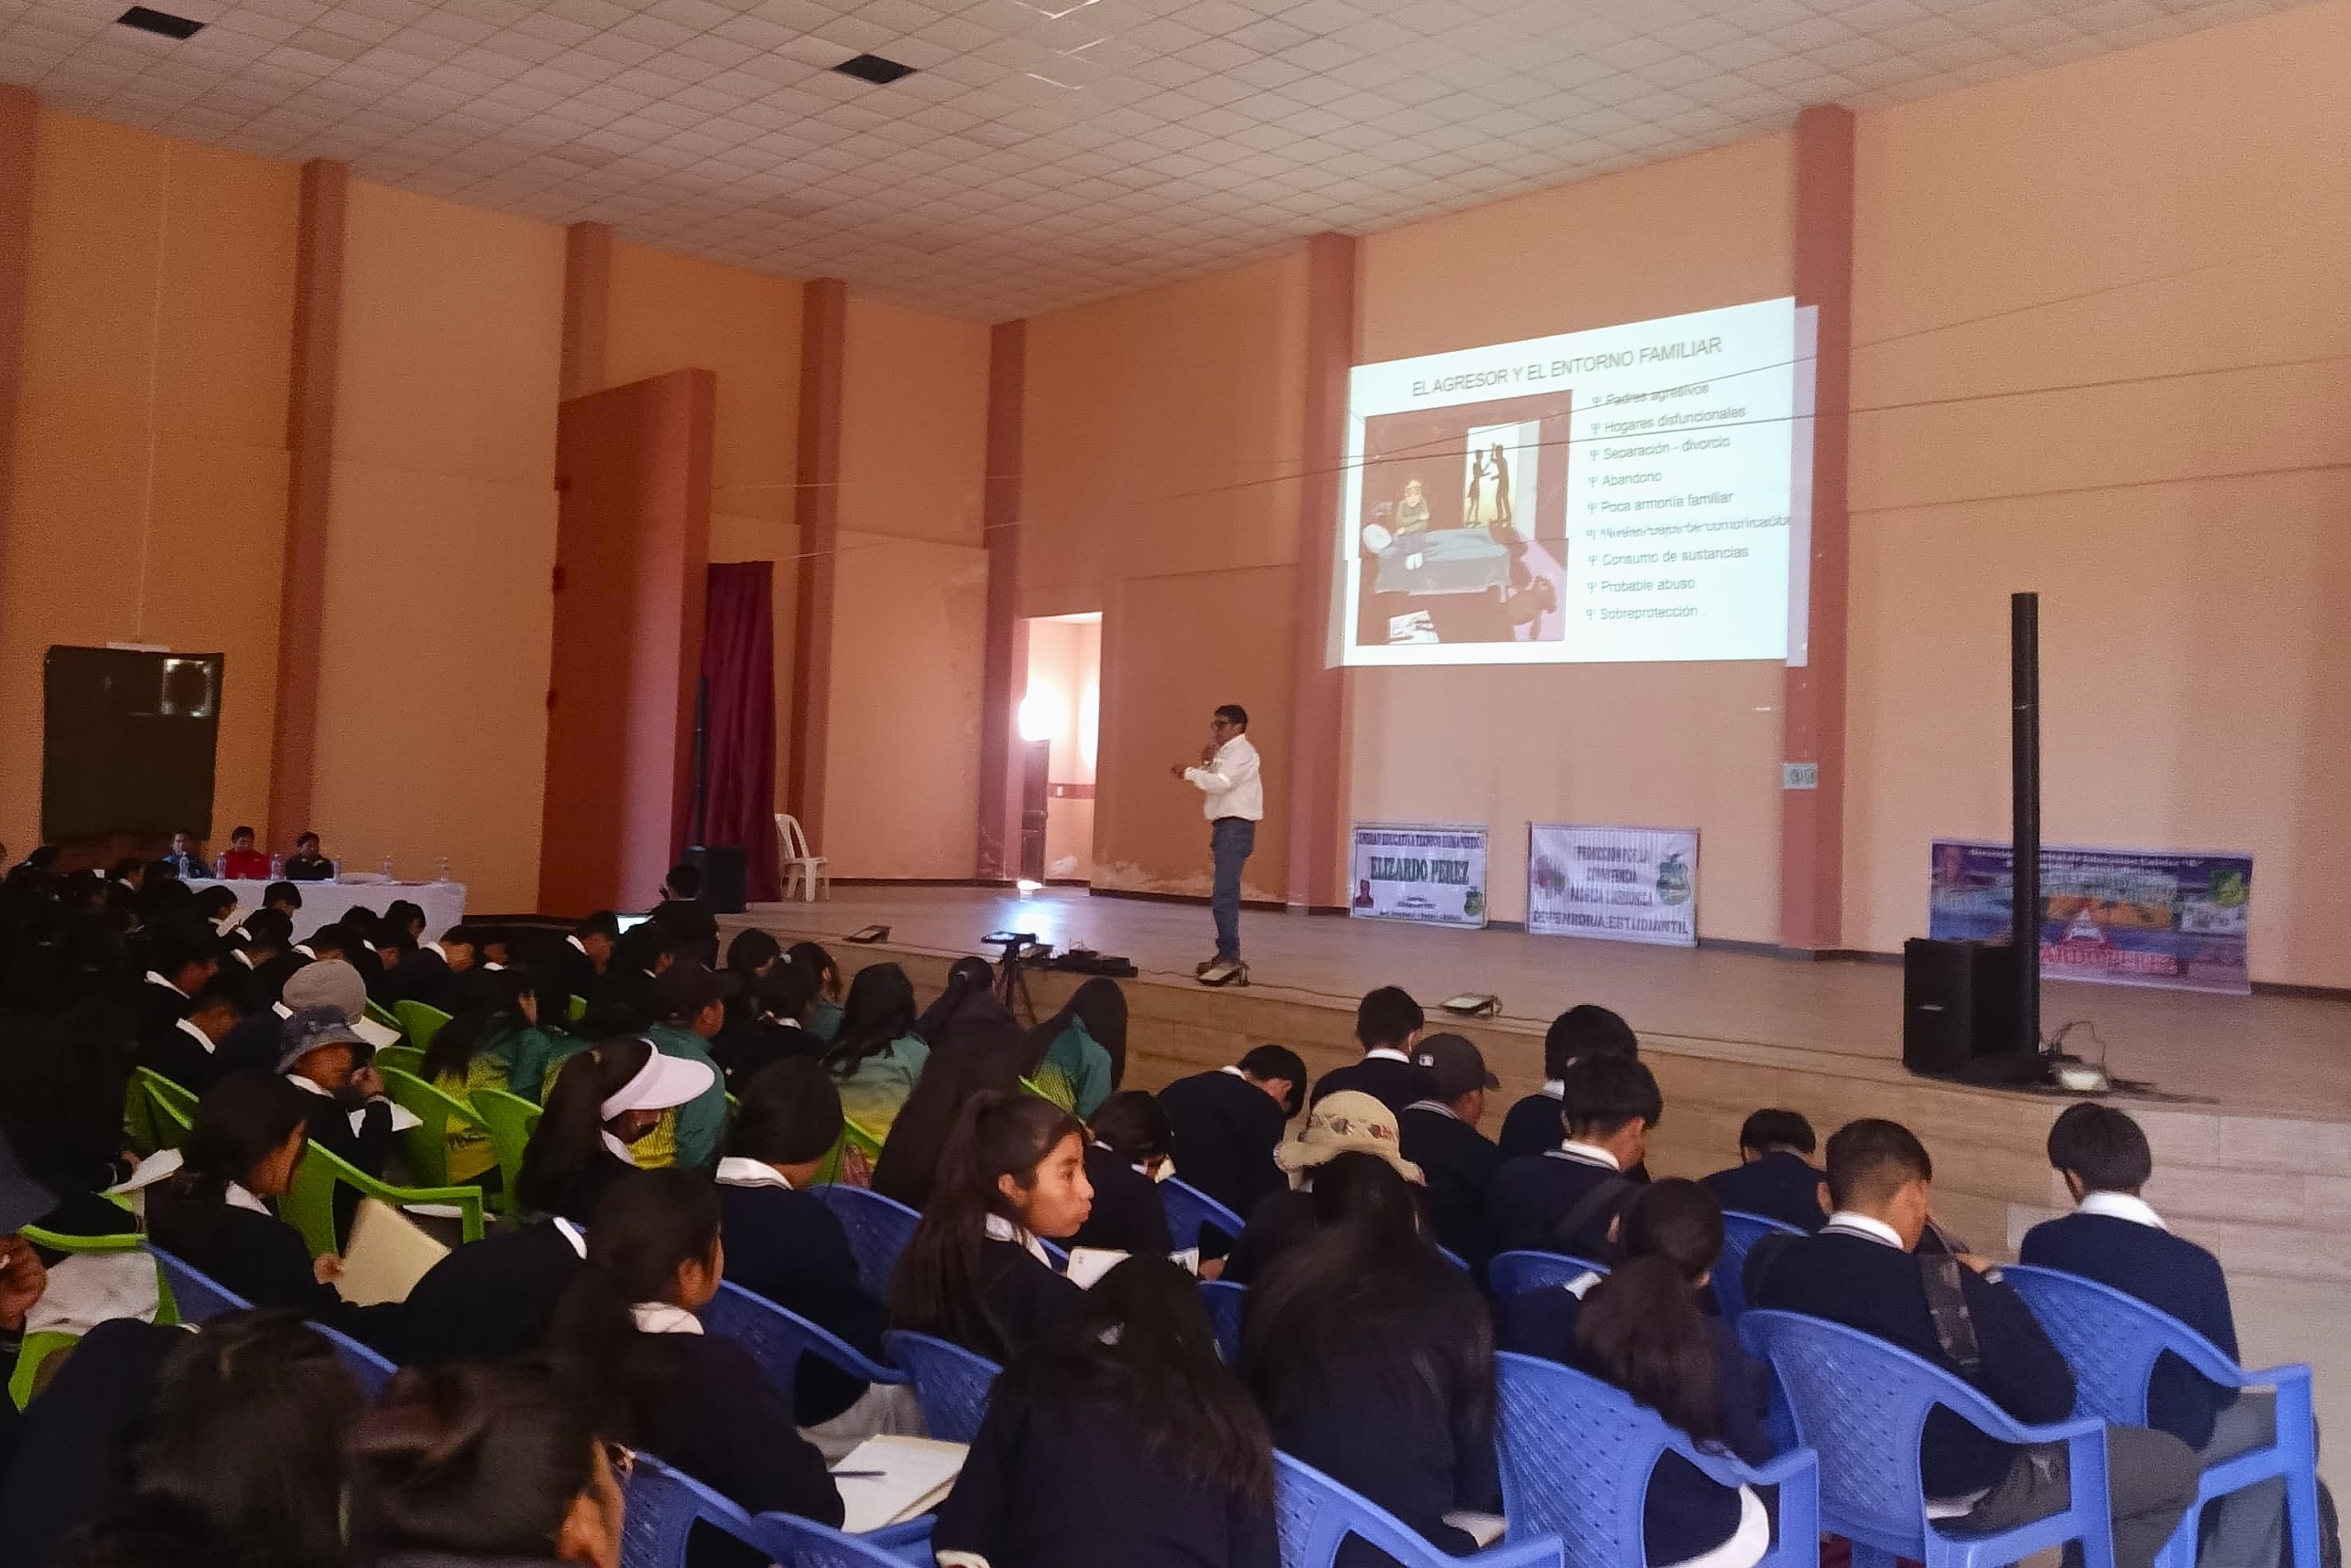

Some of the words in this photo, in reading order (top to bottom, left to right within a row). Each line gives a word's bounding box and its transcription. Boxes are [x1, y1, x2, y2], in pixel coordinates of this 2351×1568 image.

[1413, 378, 1429, 397] EL
[1432, 369, 1509, 394] AGRESOR
[1512, 366, 1524, 382] Y
[1527, 364, 1546, 382] EL
[1551, 351, 1633, 378] ENTORNO
[1640, 336, 1723, 364] FAMILIAR
[1606, 391, 1647, 406] Padres
[1605, 417, 1654, 434] Hogares
[1657, 406, 1746, 427] disfuncionales
[1603, 442, 1670, 462] Separación
[1682, 436, 1731, 452] divorcio
[1602, 471, 1662, 487] Abandono
[1601, 501, 1631, 513] Poca
[1688, 491, 1735, 506] familiar
[1603, 554, 1658, 566] Consumo
[1663, 550, 1677, 563] de
[1681, 546, 1749, 562] sustancias
[1601, 579, 1653, 593] Probable
[1370, 856, 1428, 882] ELIZARDO
[1431, 859, 1469, 886] PEREZ
[1608, 915, 1689, 934] ESTUDIANTIL
